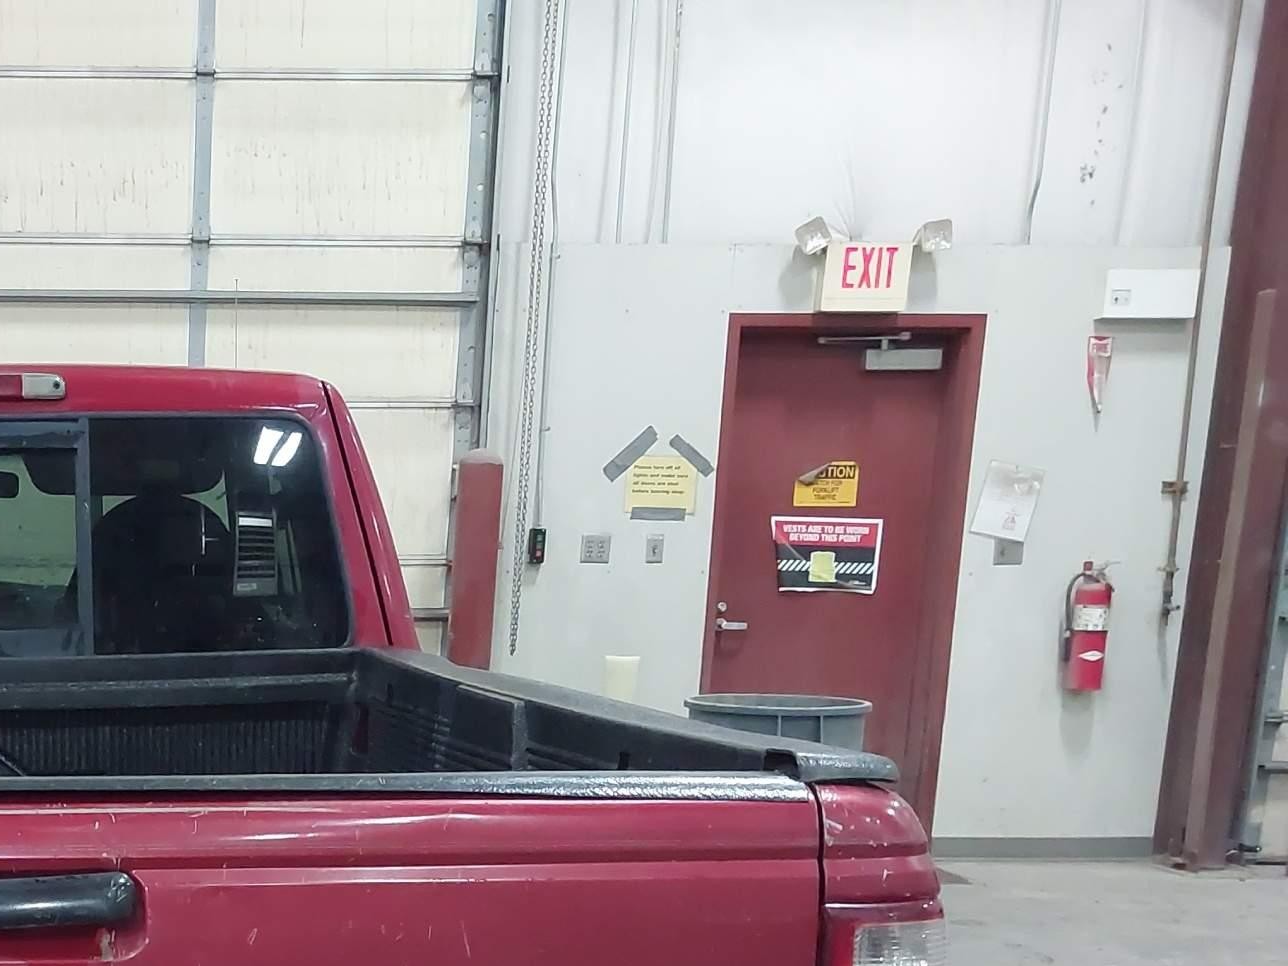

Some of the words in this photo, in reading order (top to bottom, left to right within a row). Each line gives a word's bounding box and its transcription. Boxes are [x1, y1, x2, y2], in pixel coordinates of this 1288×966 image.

[841, 246, 899, 289] EXIT
[783, 524, 807, 533] VESTS
[807, 525, 822, 533] ARE
[824, 525, 834, 533] TO
[789, 533, 820, 541] BEYOND
[821, 533, 838, 542] THIS
[838, 534, 862, 543] POINT
